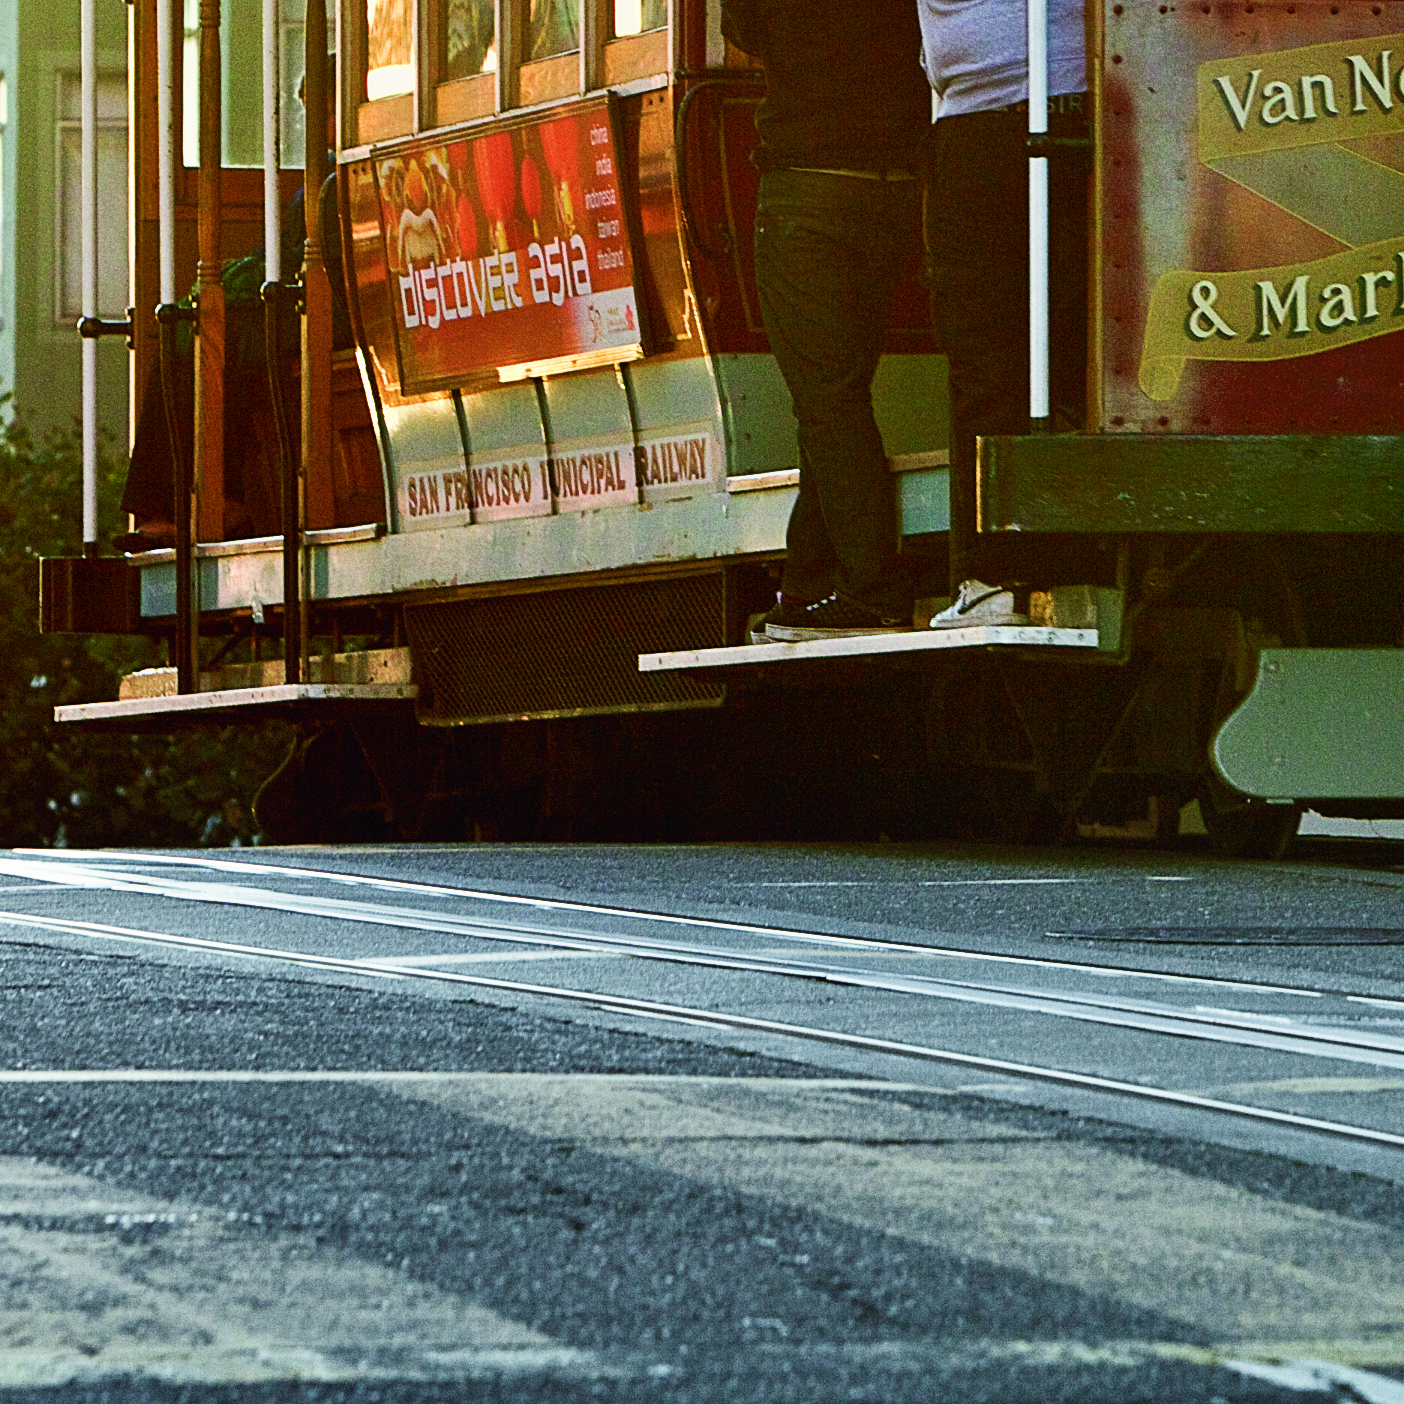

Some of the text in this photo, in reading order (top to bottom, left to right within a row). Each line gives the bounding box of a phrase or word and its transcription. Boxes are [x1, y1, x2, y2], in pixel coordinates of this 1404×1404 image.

[1215, 69, 1339, 131] Van
[590, 123, 608, 146] china
[595, 153, 613, 176] india
[584, 184, 616, 210] indonesia
[597, 215, 620, 239] taiwan
[597, 246, 624, 270] thailand
[1188, 279, 1238, 340] &
[407, 475, 440, 517] SAN
[633, 437, 707, 499] RAILWAY
